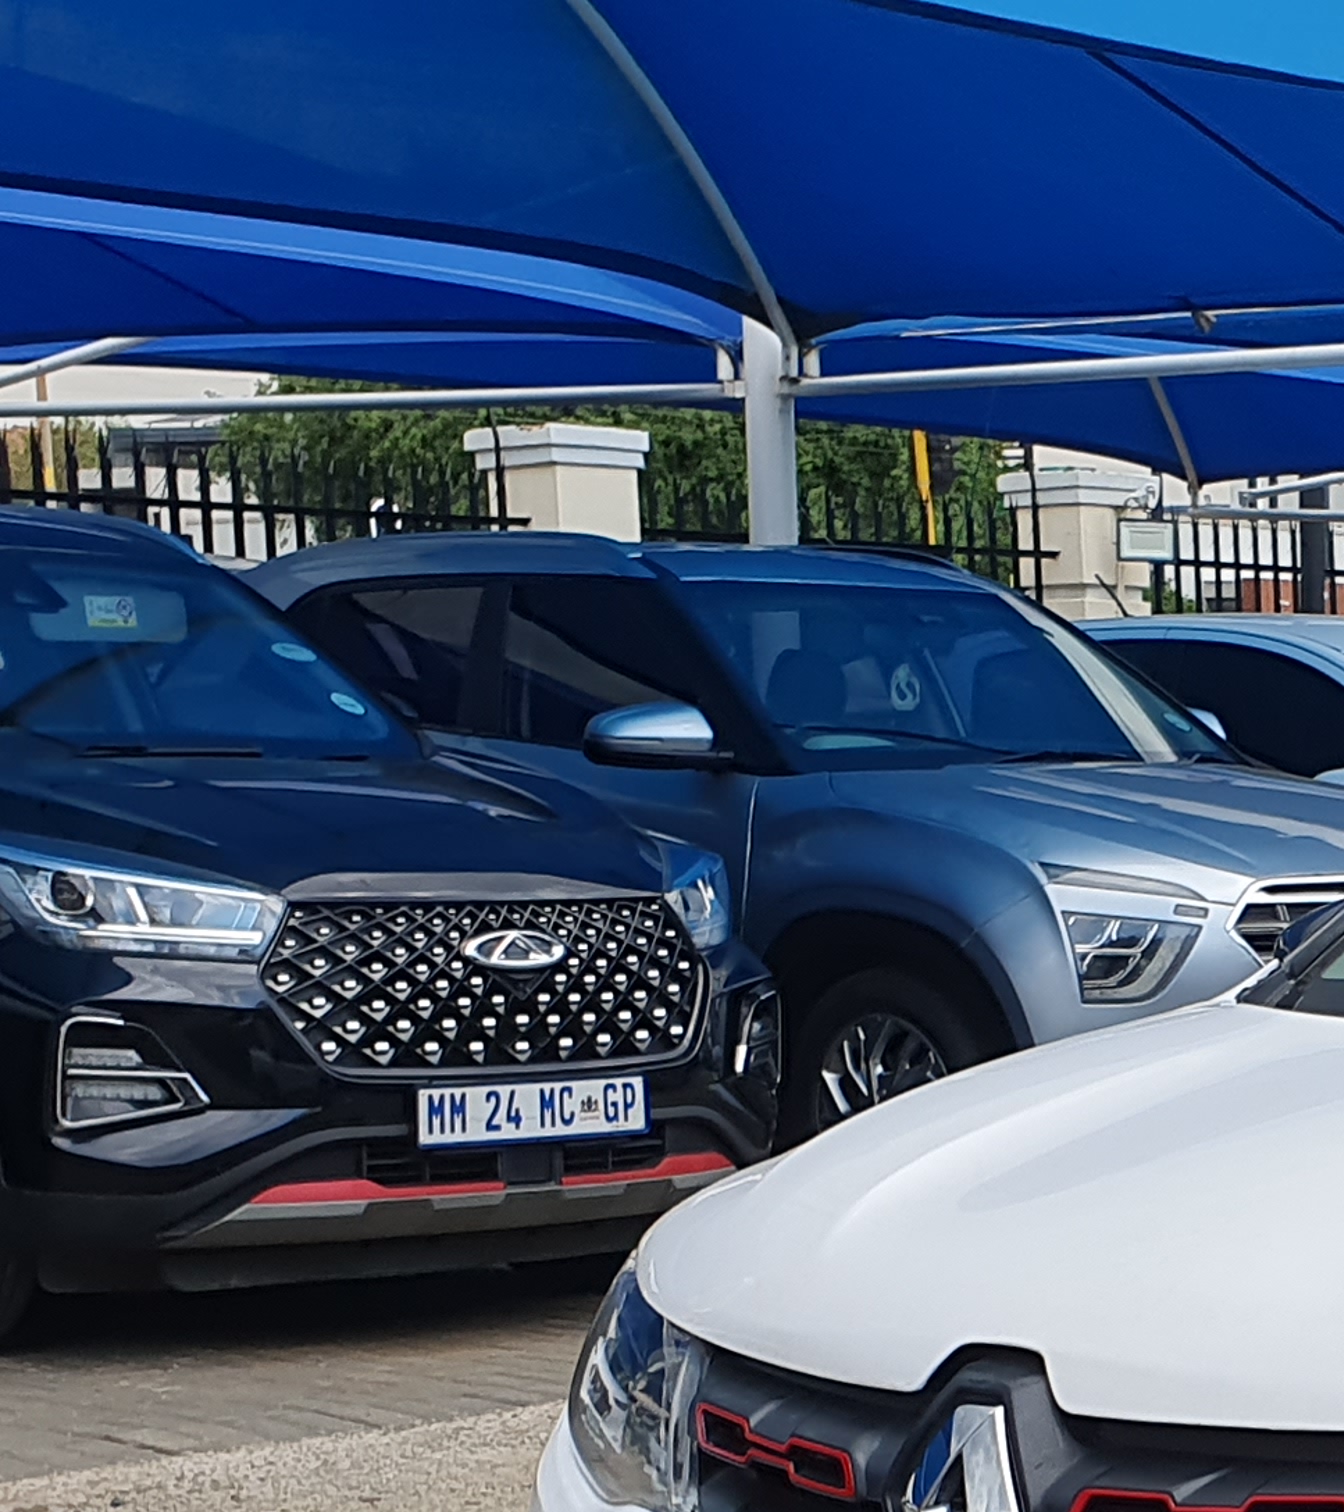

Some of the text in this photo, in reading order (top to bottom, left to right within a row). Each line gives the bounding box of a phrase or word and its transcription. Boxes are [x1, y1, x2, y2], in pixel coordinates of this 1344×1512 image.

[426, 1081, 637, 1136] MM 24 MC GP
